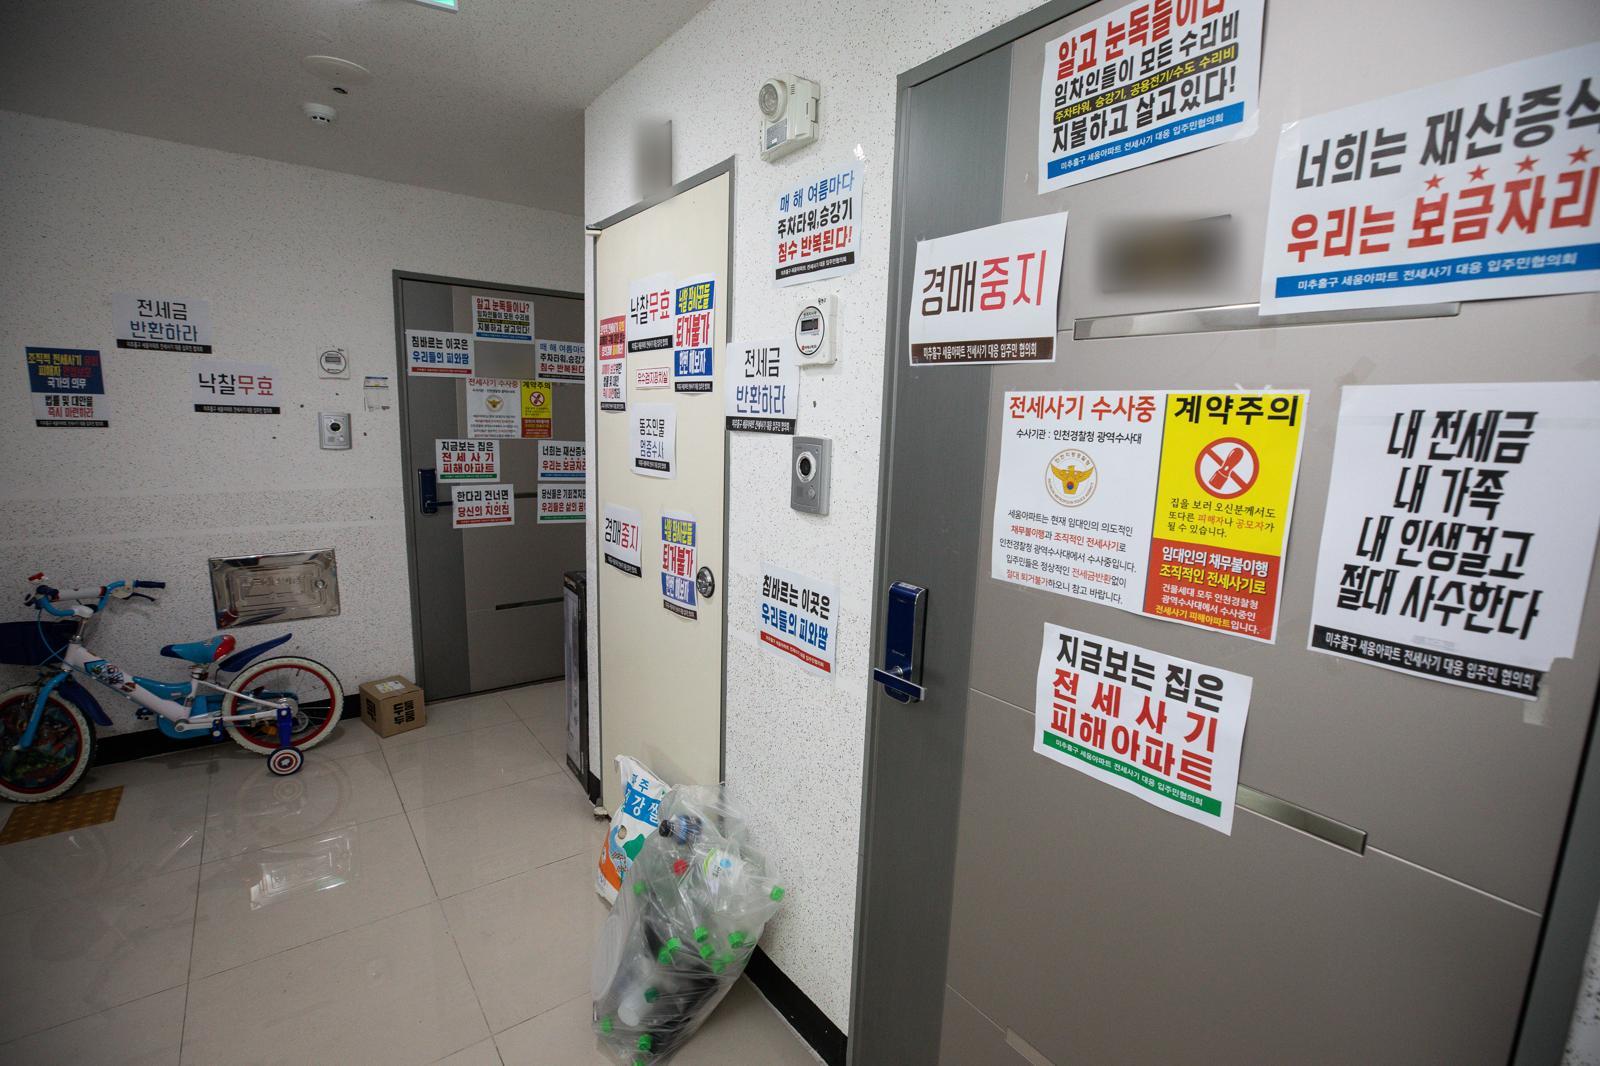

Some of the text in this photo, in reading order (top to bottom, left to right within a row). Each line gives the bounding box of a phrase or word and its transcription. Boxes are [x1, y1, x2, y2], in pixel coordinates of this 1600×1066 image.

[1055, 10, 1239, 107] 임차인들이 모든 수리비
[1057, 29, 1098, 81] 알고
[1055, 45, 1235, 122] 주차타워, 승강기, 공용전기/수도 수리비
[1052, 65, 1236, 153] 지불하고 살고있다!
[1060, 156, 1085, 170] 미추홀구
[1124, 136, 1153, 151] 전세사기
[1155, 130, 1170, 141] 대응
[1296, 128, 1407, 189] 너희는
[780, 170, 855, 213] 매 해 여름마다
[777, 197, 853, 239] 주차타워,승강기
[1287, 166, 1600, 263] 우리는 보금자리
[778, 225, 852, 263] 침수 반복된다!
[921, 249, 1047, 317] 경매중지
[1297, 277, 1338, 290] 미추홀구
[1403, 265, 1452, 280] 전세사기
[1456, 261, 1482, 274] 대응
[137, 299, 187, 321] 전세금
[630, 289, 670, 325] 낙찰무효
[130, 321, 198, 342] 반환하라
[676, 312, 710, 347] 퇴거불가
[744, 347, 780, 378] 전세금
[199, 373, 274, 395] 낙찰무효
[736, 384, 786, 415] 반환하라
[1009, 395, 1157, 423] 전세사기 수사중
[1174, 394, 1299, 426] 계약주의
[442, 441, 494, 452] 지금보는 집은
[1016, 428, 1046, 440] 수사기관
[1053, 429, 1095, 442] 인천경찰청
[1097, 431, 1142, 444] 광역수사대
[1387, 409, 1539, 465] 내 전세금
[443, 463, 495, 473] 피해아파트
[457, 490, 509, 503] 한다리 건너면
[1171, 498, 1276, 518] 집을 보러 오신분께서도
[1393, 464, 1510, 521] 내 가족
[458, 505, 483, 517] 당신의
[1051, 515, 1066, 525] 현재
[1068, 517, 1099, 531] 임대인의
[1101, 522, 1133, 537] 의도적인
[1169, 511, 1275, 532] 또다른 피해자나 공모자가
[605, 517, 639, 552] 경매중지
[1054, 533, 1084, 546] 조직적인
[1086, 537, 1126, 553] 전세사기로
[1168, 522, 1227, 538] 될 수 있습니다.
[1356, 515, 1535, 580] 내 인생걸고
[663, 544, 694, 578] 퇴거불가
[1000, 538, 1137, 573] 인천경찰청 광역수사대에서 수사중입니다.
[1006, 554, 1039, 570] 입주민들은
[1041, 562, 1070, 576] 정상적인
[1162, 546, 1269, 578] 임대인의 채무불이행
[762, 574, 830, 620] 침바르는 이곳은
[1007, 569, 1019, 580] 절대
[1072, 584, 1087, 595] 참고
[1089, 588, 1123, 605] 바랍니다.
[1160, 564, 1266, 595] 조직적인 전세사기로
[1162, 595, 1256, 621] 광역수사대에서 수사중인
[1197, 588, 1212, 599] 모두
[1214, 594, 1258, 610] 인천경찰청
[1336, 563, 1545, 640] 절대 사수한다
[762, 603, 797, 637] 우리들의
[799, 618, 829, 651] 피와땀
[1056, 634, 1224, 713] 지금보는 집은
[1325, 632, 1357, 652] 미추홀구
[1403, 649, 1441, 672] 전세사기
[1443, 658, 1464, 676] 대응
[1467, 663, 1499, 683] 입주민
[1501, 669, 1535, 691] 협의회
[1051, 703, 1213, 792] 피해아파트
